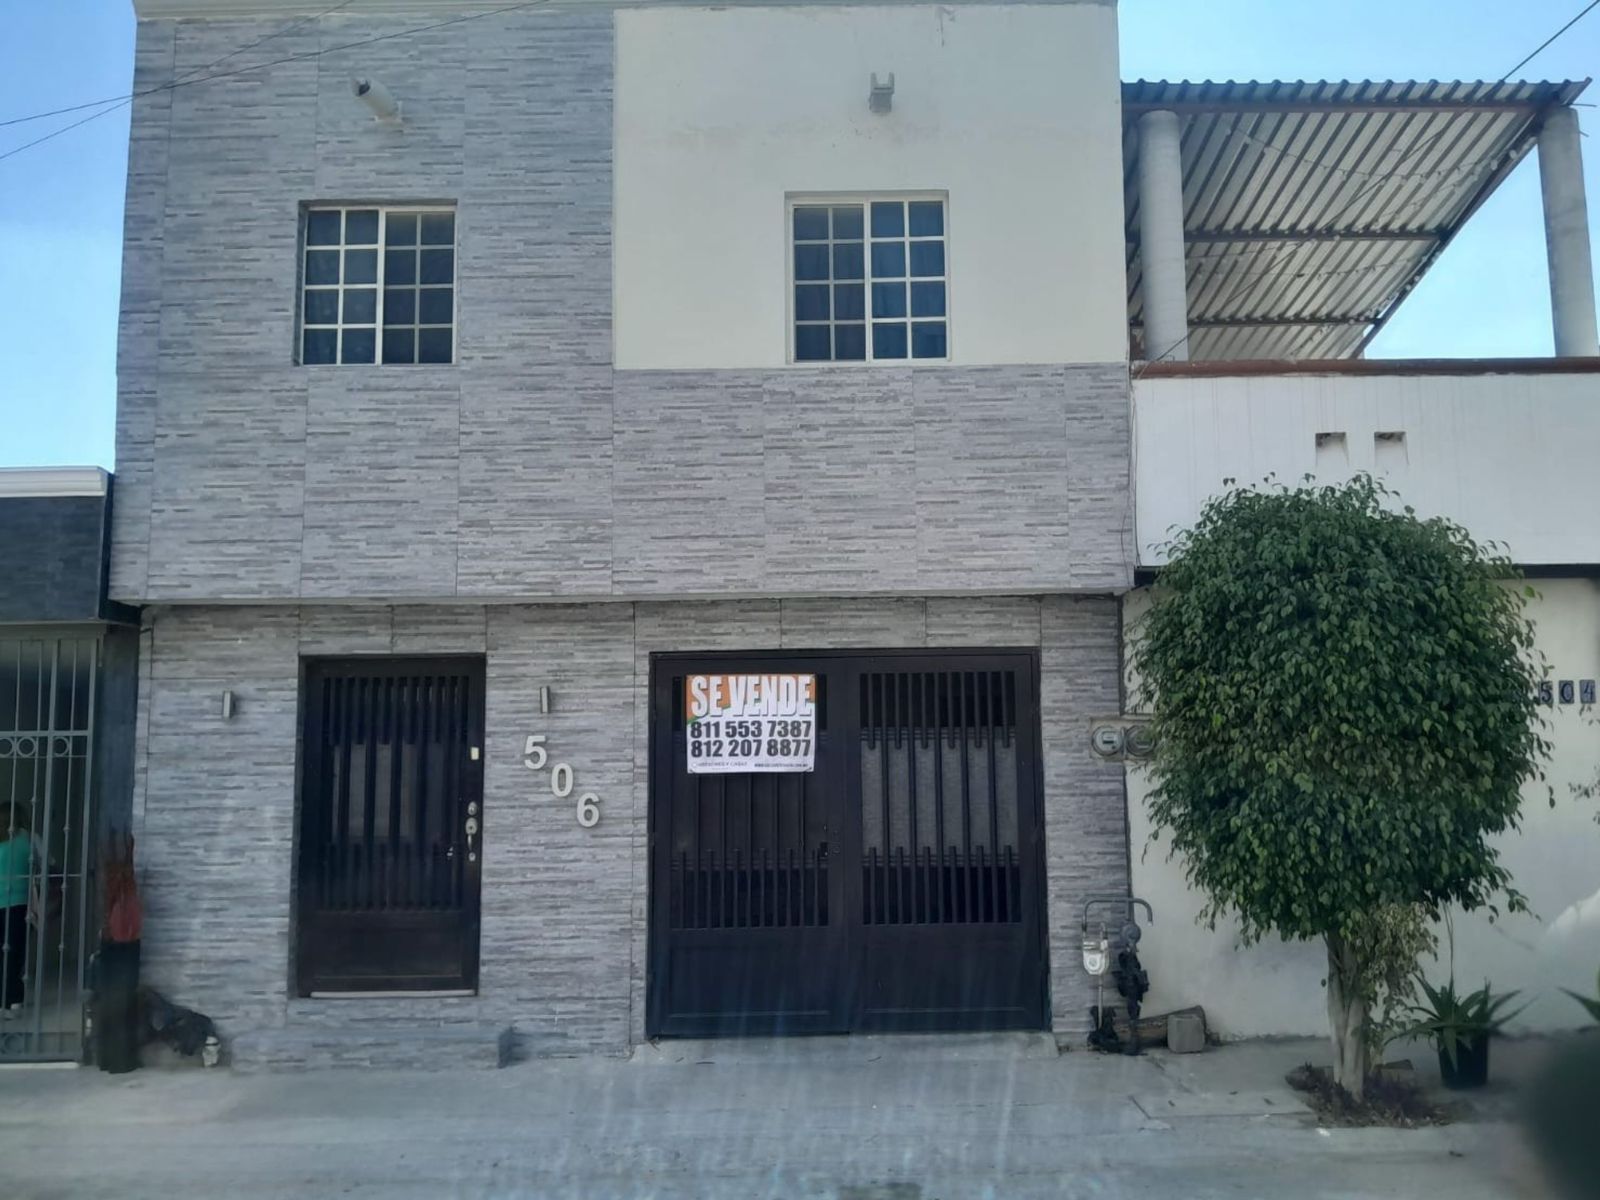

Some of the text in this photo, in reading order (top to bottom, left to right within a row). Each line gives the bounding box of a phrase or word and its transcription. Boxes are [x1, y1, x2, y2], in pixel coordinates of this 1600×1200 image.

[691, 675, 812, 717] SE VENDE
[1540, 681, 1595, 703] 504
[690, 720, 812, 739] 811 553 7387
[690, 739, 811, 758] 812 207 8877
[524, 735, 600, 828] 506
